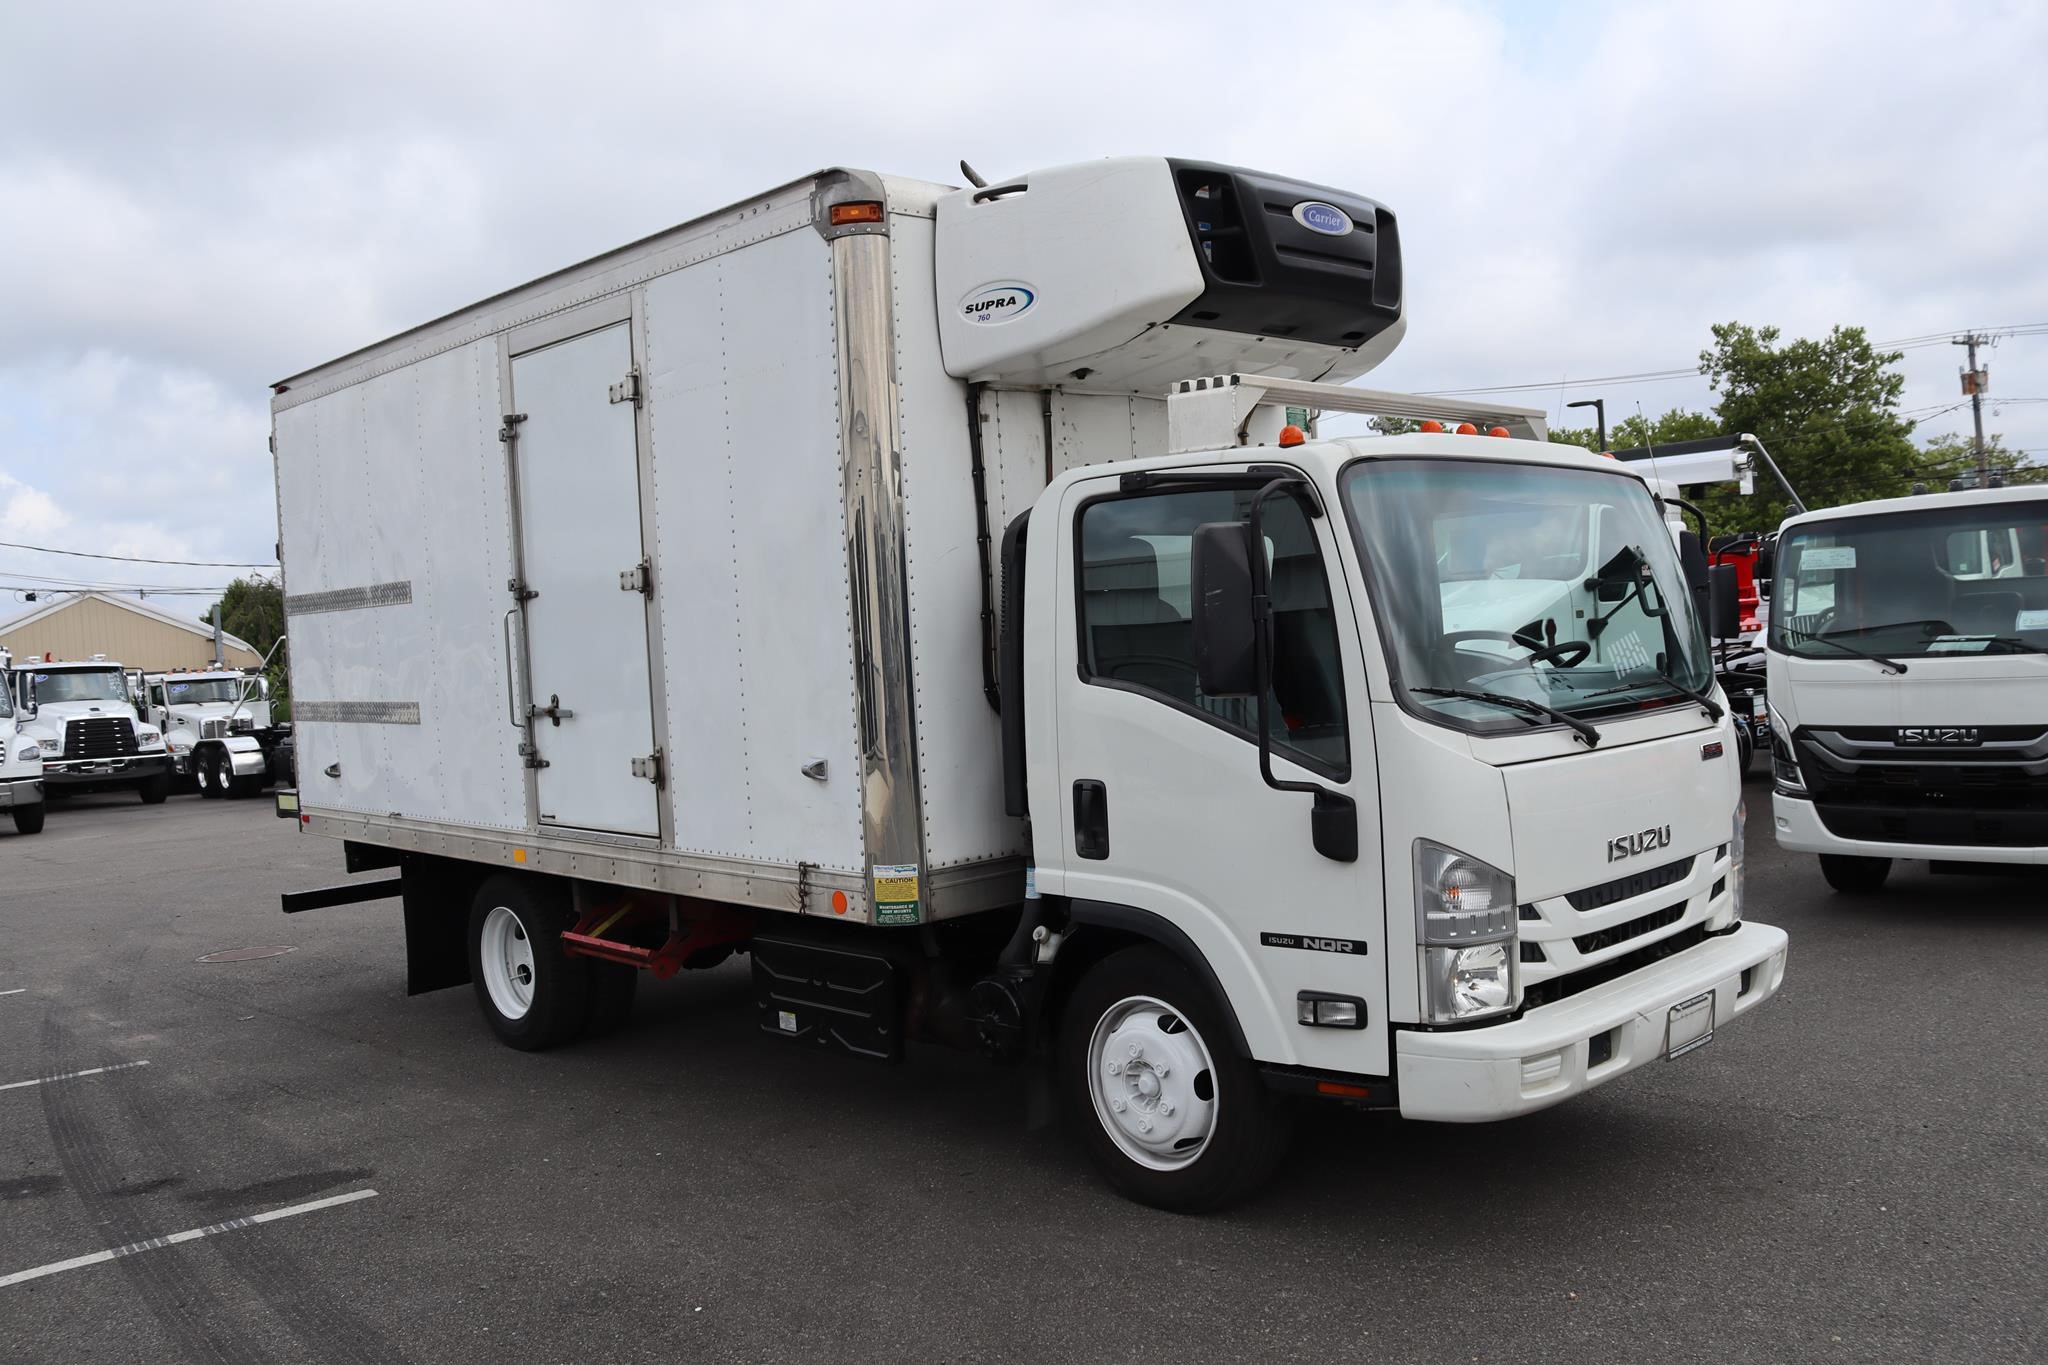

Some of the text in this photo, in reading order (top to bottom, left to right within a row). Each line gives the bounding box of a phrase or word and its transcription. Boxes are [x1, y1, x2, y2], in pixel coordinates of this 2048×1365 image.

[1309, 210, 1341, 226] Carrier
[965, 296, 1016, 314] SUPRA
[977, 313, 991, 322] 760
[1898, 729, 1978, 742] ISUZU
[1608, 824, 1670, 863] ISUZU
[1268, 936, 1353, 953] ISUZU NQR
